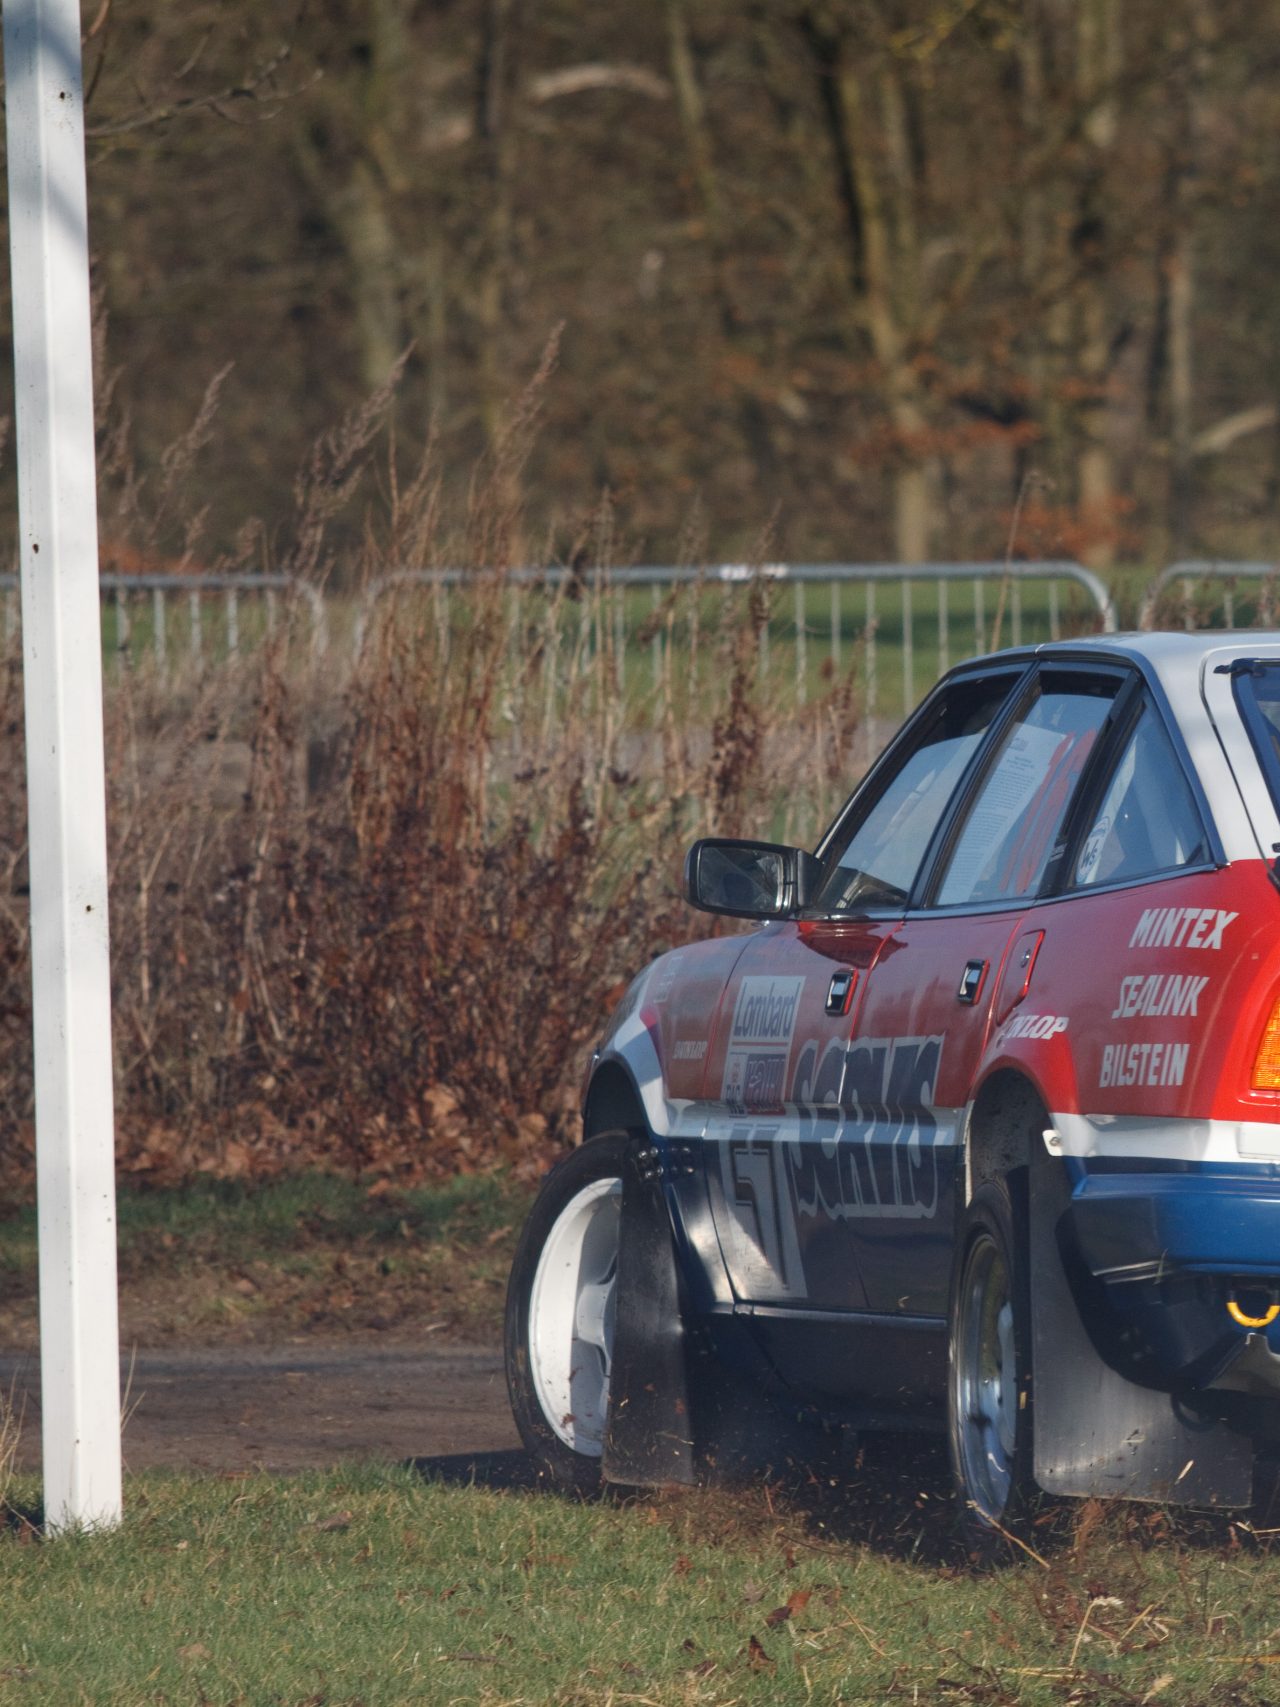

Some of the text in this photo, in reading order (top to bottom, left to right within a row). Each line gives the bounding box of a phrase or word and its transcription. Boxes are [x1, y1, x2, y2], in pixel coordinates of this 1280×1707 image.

[1129, 907, 1239, 949] MINTEX
[733, 981, 801, 1037] Lombard
[1112, 975, 1210, 1019] SEALINK
[1100, 1044, 1190, 1088] BILSTEIN
